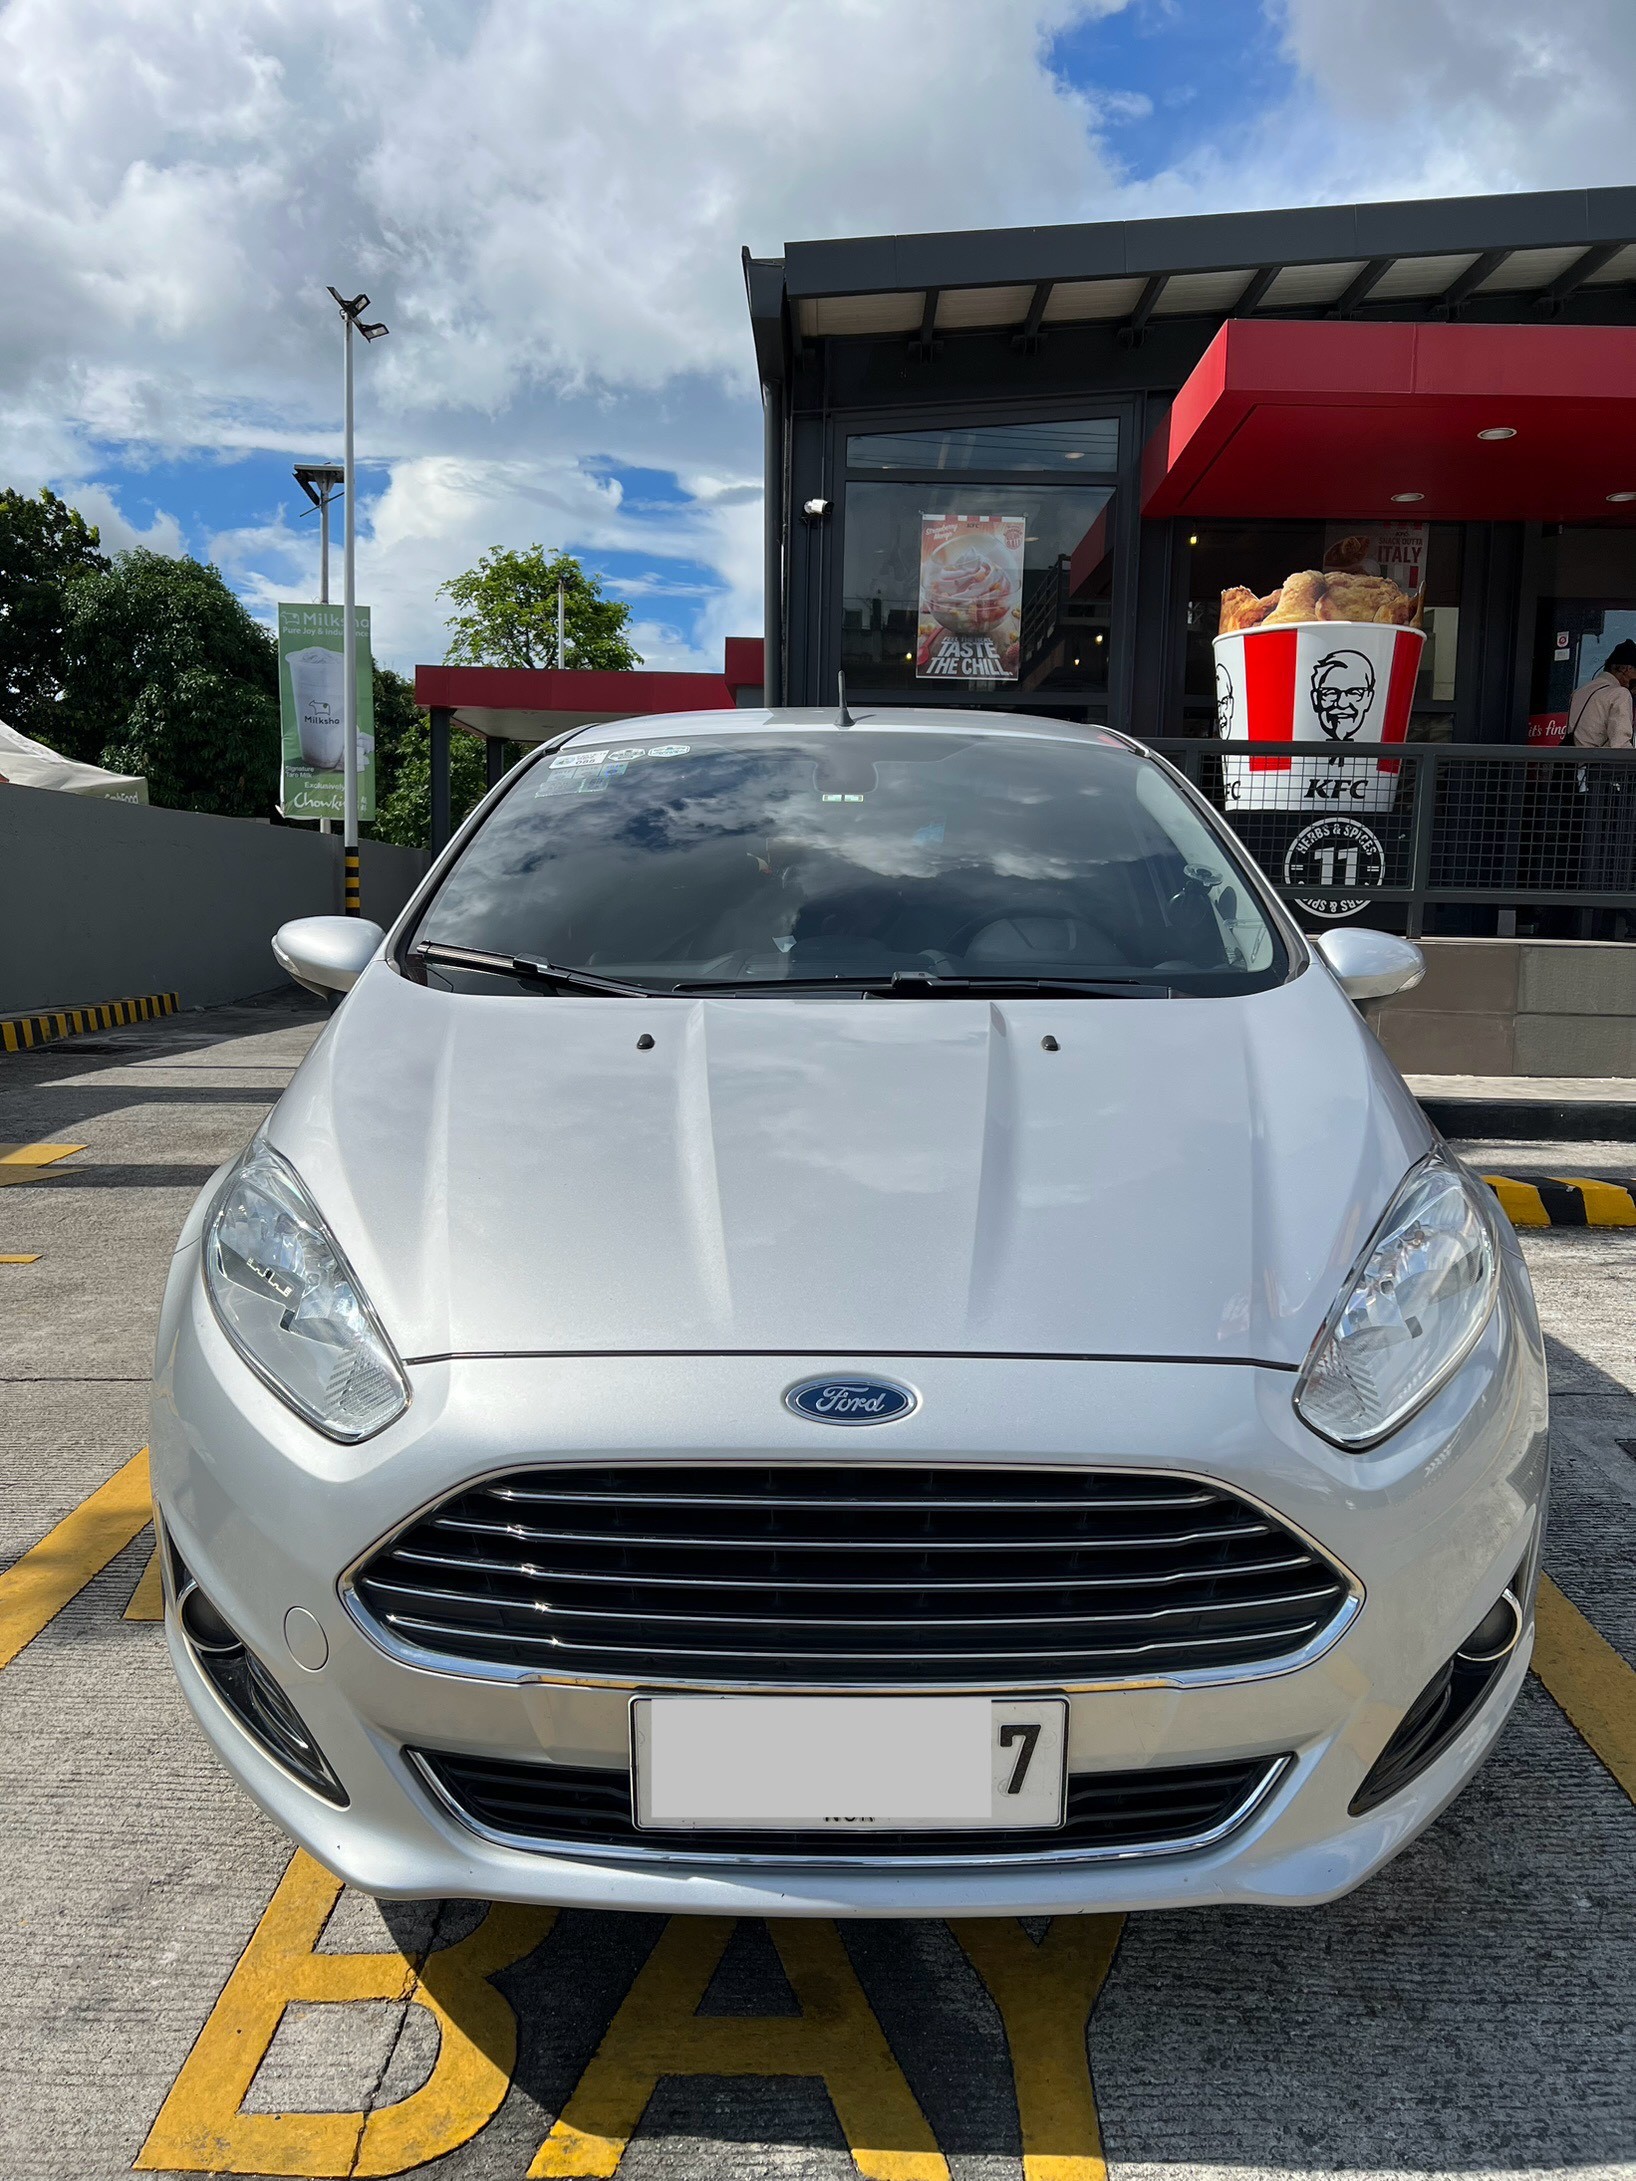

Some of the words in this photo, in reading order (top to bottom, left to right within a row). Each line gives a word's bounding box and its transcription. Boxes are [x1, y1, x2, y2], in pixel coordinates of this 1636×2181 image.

[1378, 545, 1422, 564] ITALY
[282, 626, 302, 634] Pure
[303, 627, 316, 636] Joy
[317, 627, 324, 635] &
[325, 628, 369, 637] Indunce
[937, 640, 1000, 659] TASTE
[926, 656, 960, 674] THE
[961, 657, 1013, 676] CHILL.
[304, 715, 340, 725] Milksha
[1528, 722, 1542, 738] it's
[1545, 719, 1568, 740] fing
[304, 781, 345, 792] Exclusively
[1225, 780, 1242, 800] FC
[1303, 778, 1369, 800] KFC
[293, 791, 345, 811] Chowki
[1296, 824, 1331, 855] HERBS
[1332, 823, 1342, 835] &
[1343, 825, 1378, 856] SPICES
[1314, 846, 1359, 886] 11
[815, 1385, 887, 1412] Ford
[133, 1847, 1128, 2181] BAY
